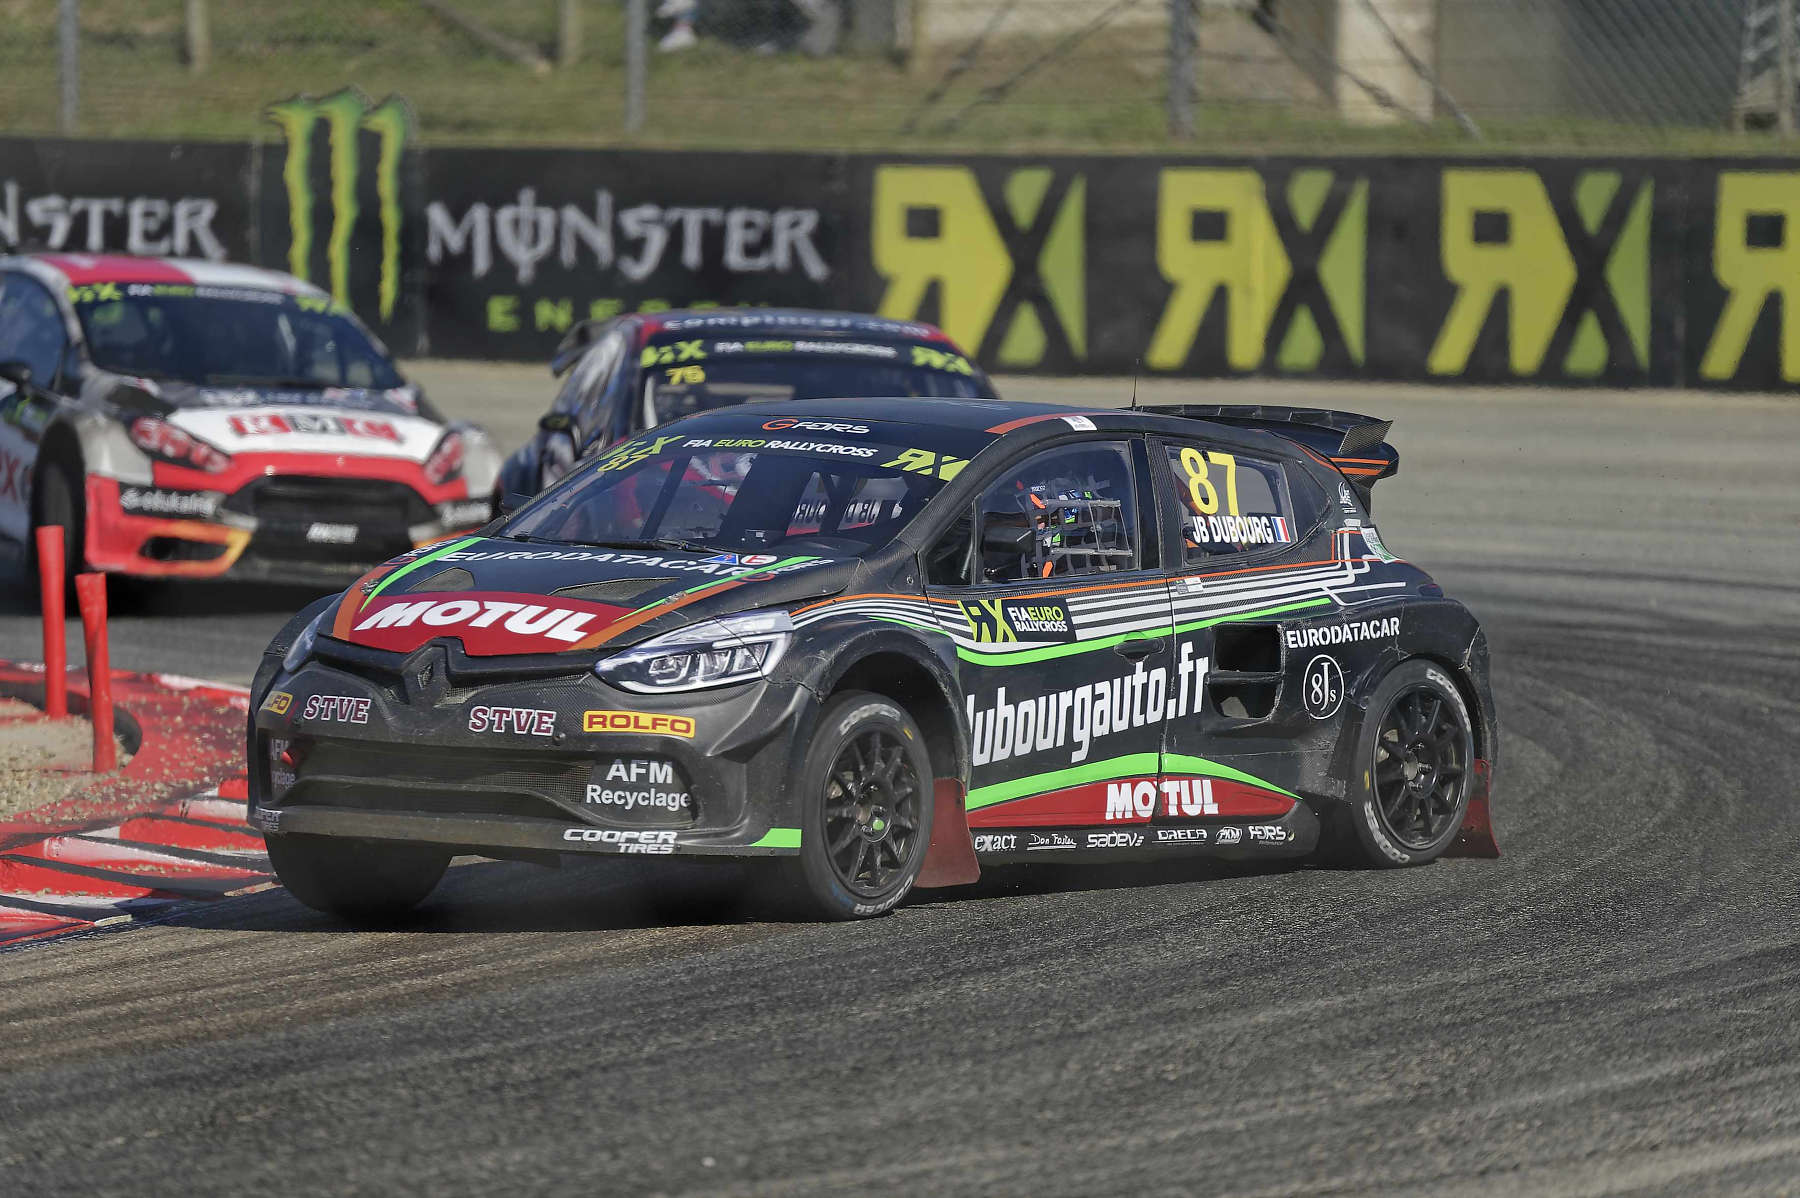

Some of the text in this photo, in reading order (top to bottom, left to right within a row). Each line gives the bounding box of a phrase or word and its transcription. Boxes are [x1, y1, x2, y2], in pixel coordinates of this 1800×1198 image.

[425, 187, 830, 285] MONSTER
[683, 439, 878, 457] FIA EURO RALLYCROSS
[598, 454, 650, 472] 87
[1180, 447, 1239, 516] 87
[1192, 515, 1274, 544] JB DUBOURG
[354, 598, 599, 642] MOTUL
[1014, 620, 1068, 633] RALLYCROSS
[1286, 617, 1400, 649] EURODATACAR
[303, 695, 372, 724] STVE
[469, 706, 557, 737] STVE
[587, 713, 692, 734] ROLFO
[606, 759, 674, 784] AFM
[586, 784, 692, 812] Recyclage
[1105, 779, 1219, 820] MOTUL
[563, 828, 678, 845] COOPER
[617, 843, 675, 854] TIRES
[974, 834, 1017, 852] exact
